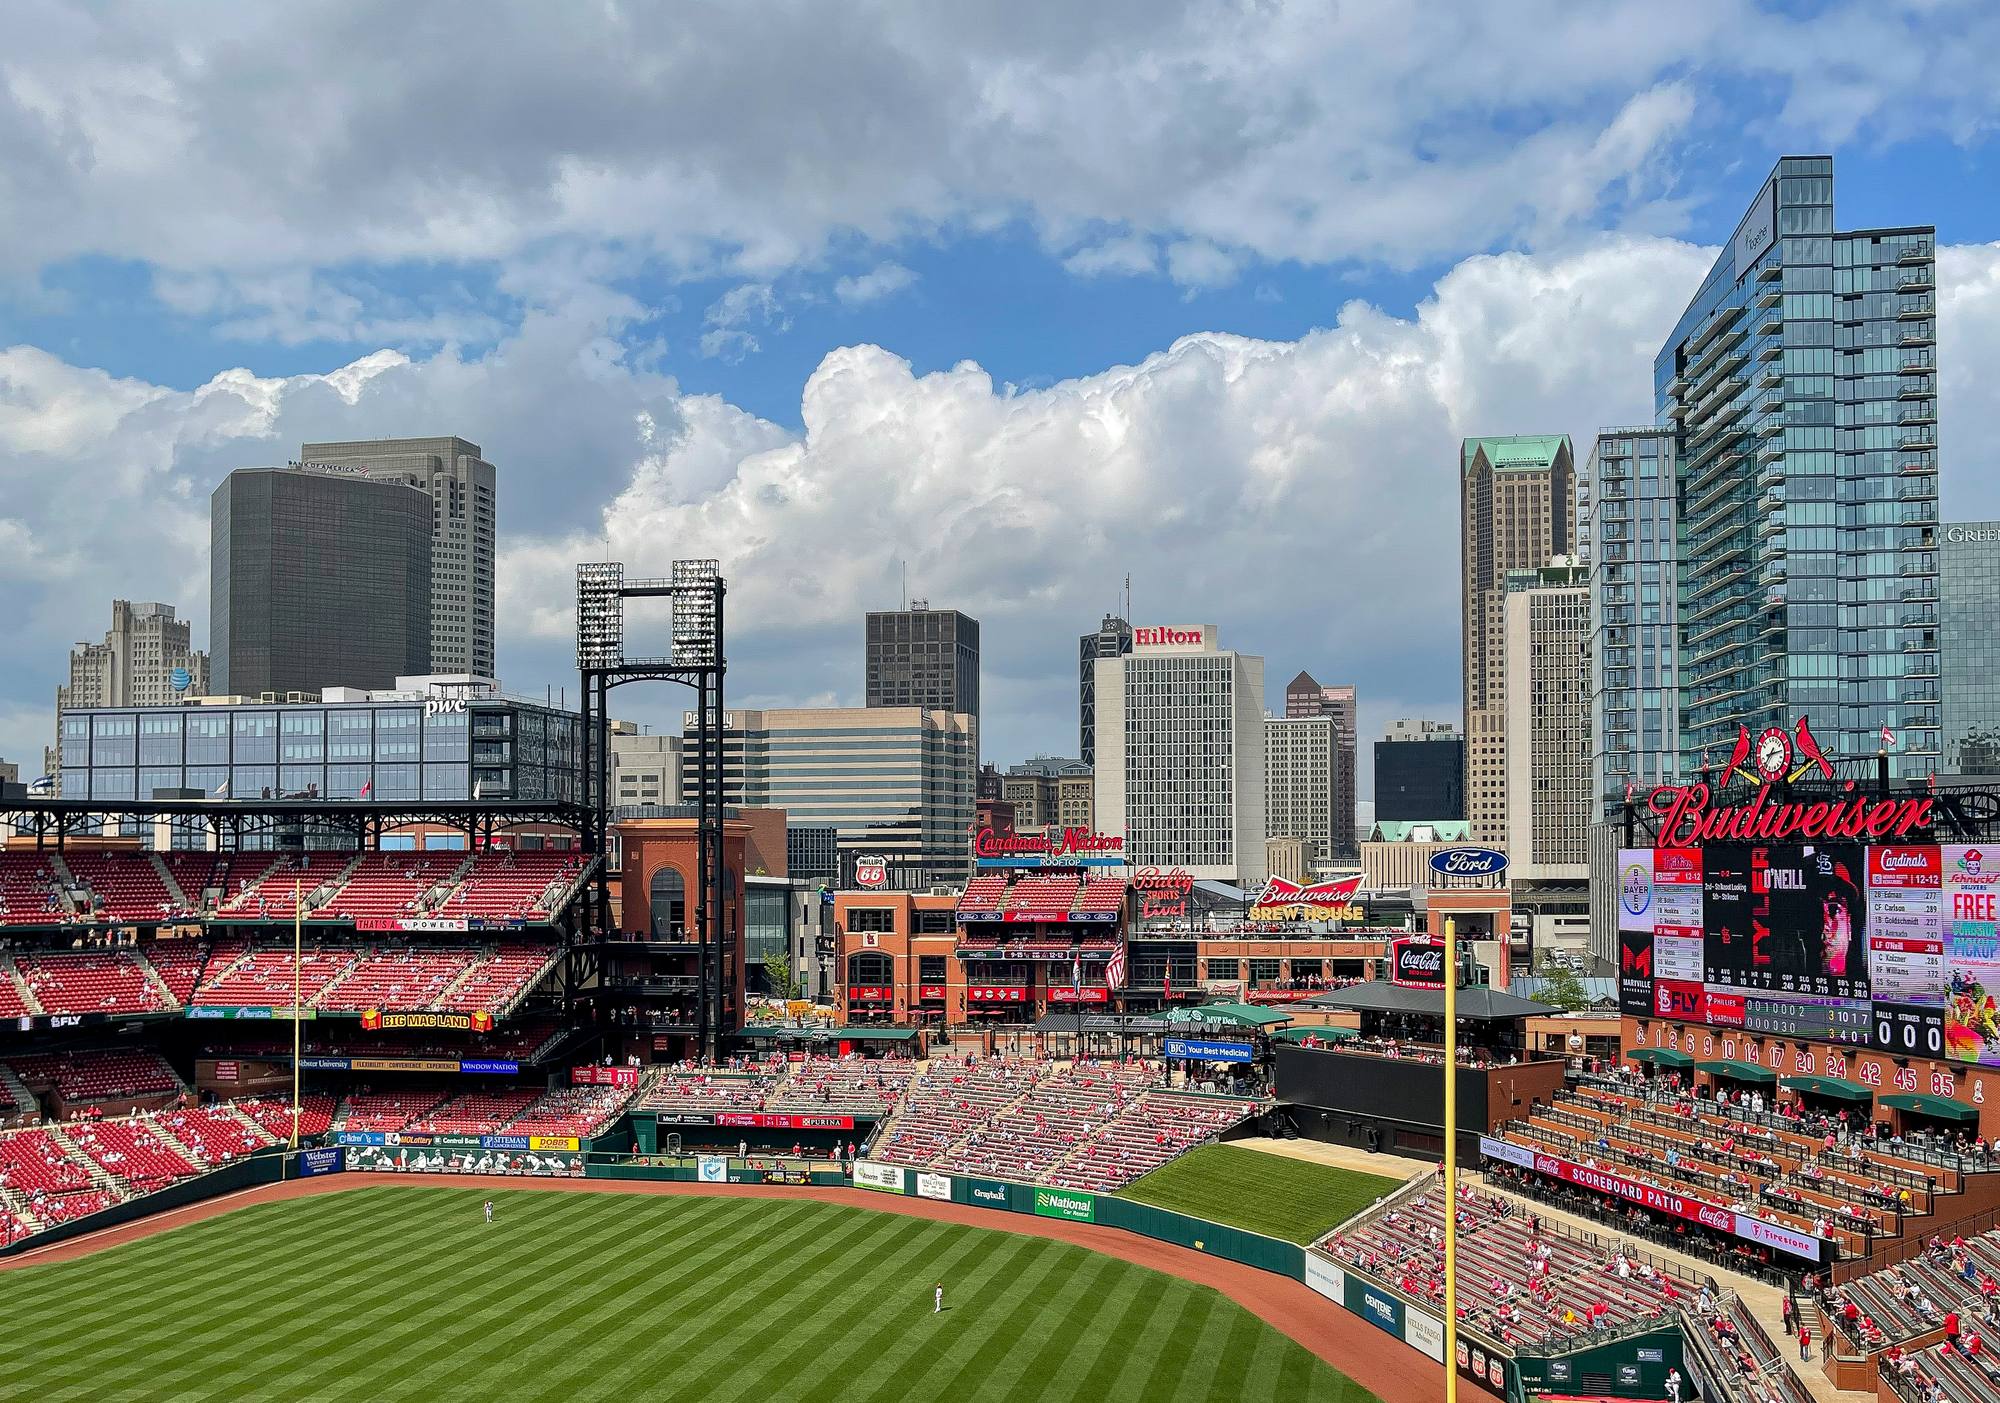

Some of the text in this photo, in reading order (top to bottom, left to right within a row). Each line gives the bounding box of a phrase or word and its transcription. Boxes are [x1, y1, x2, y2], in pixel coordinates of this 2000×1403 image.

[321, 464, 356, 473] AMERICA
[1948, 527, 2000, 542] GREE
[1135, 626, 1203, 645] Hilton
[424, 699, 467, 718] pwc
[1648, 782, 1934, 848] Budweiser
[976, 825, 1122, 856] Cardinals Nation
[1040, 858, 1081, 866] ROOFTOP
[1445, 851, 1493, 871] Ford
[1881, 849, 1928, 870] Cardinals
[860, 868, 881, 881] 66
[1133, 866, 1194, 895] Bally
[1686, 872, 1701, 881] 12-12
[1764, 869, 1806, 890] O'NEILL
[1916, 874, 1938, 884] 12-12
[1147, 890, 1180, 900] SPORTS
[1624, 886, 1649, 894] BAYER
[1143, 901, 1185, 919] Live!
[1249, 906, 1364, 921] BREW HOUSE
[1752, 848, 1770, 966] TYLER
[1953, 893, 1996, 921] FREE
[358, 920, 395, 929] THAT'S A
[1875, 941, 1904, 950] LF O'Neill
[1401, 950, 1442, 971] Coca-Cola
[1886, 966, 1909, 975] Williams
[1623, 979, 1650, 989] MARYVILLE
[1781, 982, 1793, 990] .240
[1815, 986, 1828, 994] .719
[1887, 979, 1900, 987] Sosa
[1249, 991, 1290, 999] Budweiser
[1838, 988, 1849, 996] 2.0
[1853, 990, 1867, 998] 38.0
[1671, 990, 1699, 1014] FLY
[1713, 999, 1868, 1024] PHILLIES 0 0 1 0 0 0 2 3 10 1 7
[1876, 1010, 1941, 1025] BALLS STRIKES OUTS
[60, 1015, 82, 1026] FLY
[383, 1015, 469, 1029] BIG MAC LAND
[1207, 1015, 1238, 1025] MVP Deck
[1713, 1014, 1868, 1044] CARDINALS 0 0 0 0 3 0 3 4 0 1
[1879, 1021, 1941, 1052] 0 0 0
[1170, 1043, 1184, 1053] BJC
[1219, 1049, 1250, 1057] Medicine
[319, 1059, 347, 1069] University
[461, 1061, 518, 1070] WINDOW NATION
[1656, 1029, 1954, 1098] 1 2 6 9 10 14 17 20 24 42 45 85
[663, 1115, 681, 1123] Mercy
[810, 1118, 841, 1126] PURINA
[493, 1136, 527, 1144] SITEMAN
[539, 1138, 568, 1146] DOBBS
[306, 1151, 337, 1161] Webster
[307, 1158, 336, 1167] UNIVERSITY
[1572, 1167, 1643, 1201] SCOREBOARD
[1648, 1191, 1683, 1213] PATIO
[1048, 1190, 1091, 1212] National
[1763, 1228, 1811, 1251] Firestone
[1365, 1293, 1393, 1318] CENTENE
[1407, 1317, 1441, 1342] WELLS FARGO
[1416, 1331, 1433, 1346] Advisors
